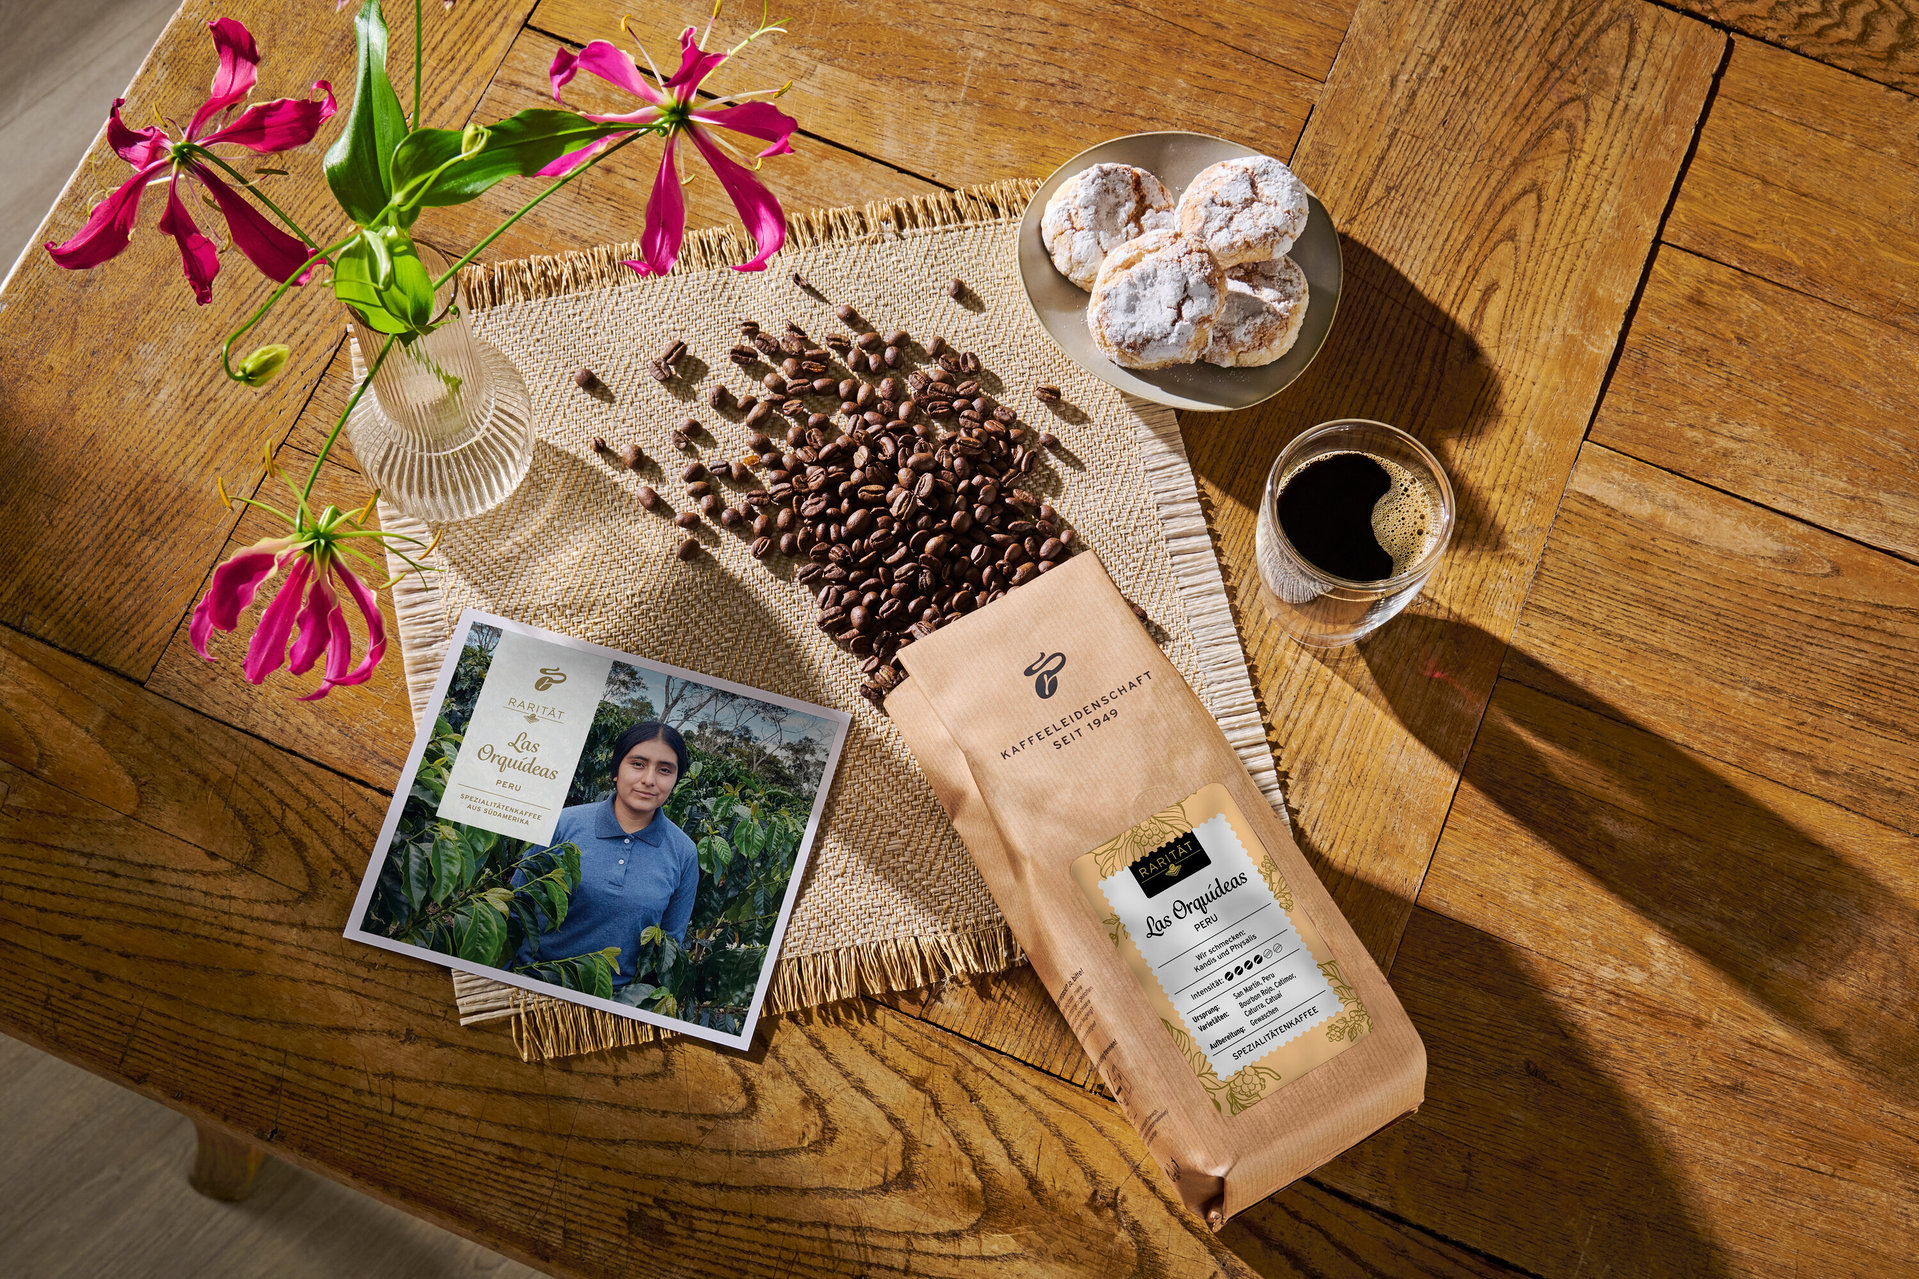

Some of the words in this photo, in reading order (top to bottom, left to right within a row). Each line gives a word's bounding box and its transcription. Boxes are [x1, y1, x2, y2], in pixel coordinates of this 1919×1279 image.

[508, 697, 565, 720] RARITÄT
[1000, 670, 1152, 760] KAFFEELEIDENSCHAFT
[508, 731, 540, 754] Las
[1053, 728, 1083, 750] SEIT
[1087, 708, 1118, 731] 1949
[477, 743, 559, 781] Orquídeas
[496, 779, 522, 792] PERU
[460, 793, 542, 821] SPEZIALITÄTENKAFFEE
[467, 804, 481, 812] AUS
[483, 807, 530, 826] SÜDAMERIKA
[1138, 841, 1194, 878] RARITÄT
[1146, 914, 1172, 939] Las
[1172, 872, 1248, 920] Orquídeas
[1193, 914, 1218, 932] PERU
[1193, 957, 1217, 973] Kandis
[1217, 950, 1230, 961] und
[1230, 933, 1257, 955] Physalis
[1195, 950, 1208, 961] Wir
[1208, 929, 1246, 956] schmecken:
[1191, 977, 1225, 1001] Intensität:
[1233, 990, 1244, 1000] San
[1262, 972, 1276, 984] Peru
[1238, 994, 1262, 1009] Bourbon
[1261, 986, 1275, 999] Rojo,
[1274, 973, 1297, 989] Catimor,
[1192, 1003, 1221, 1024] Ursprung:
[1198, 1011, 1230, 1033] Varietäten:
[1244, 1002, 1266, 1017] Caturra,
[1209, 1025, 1246, 1051] Aufbereitung:
[1250, 1006, 1280, 1027] Gewaschen
[1231, 1005, 1319, 1061] SPEZIALITÄTENKAFFEE
